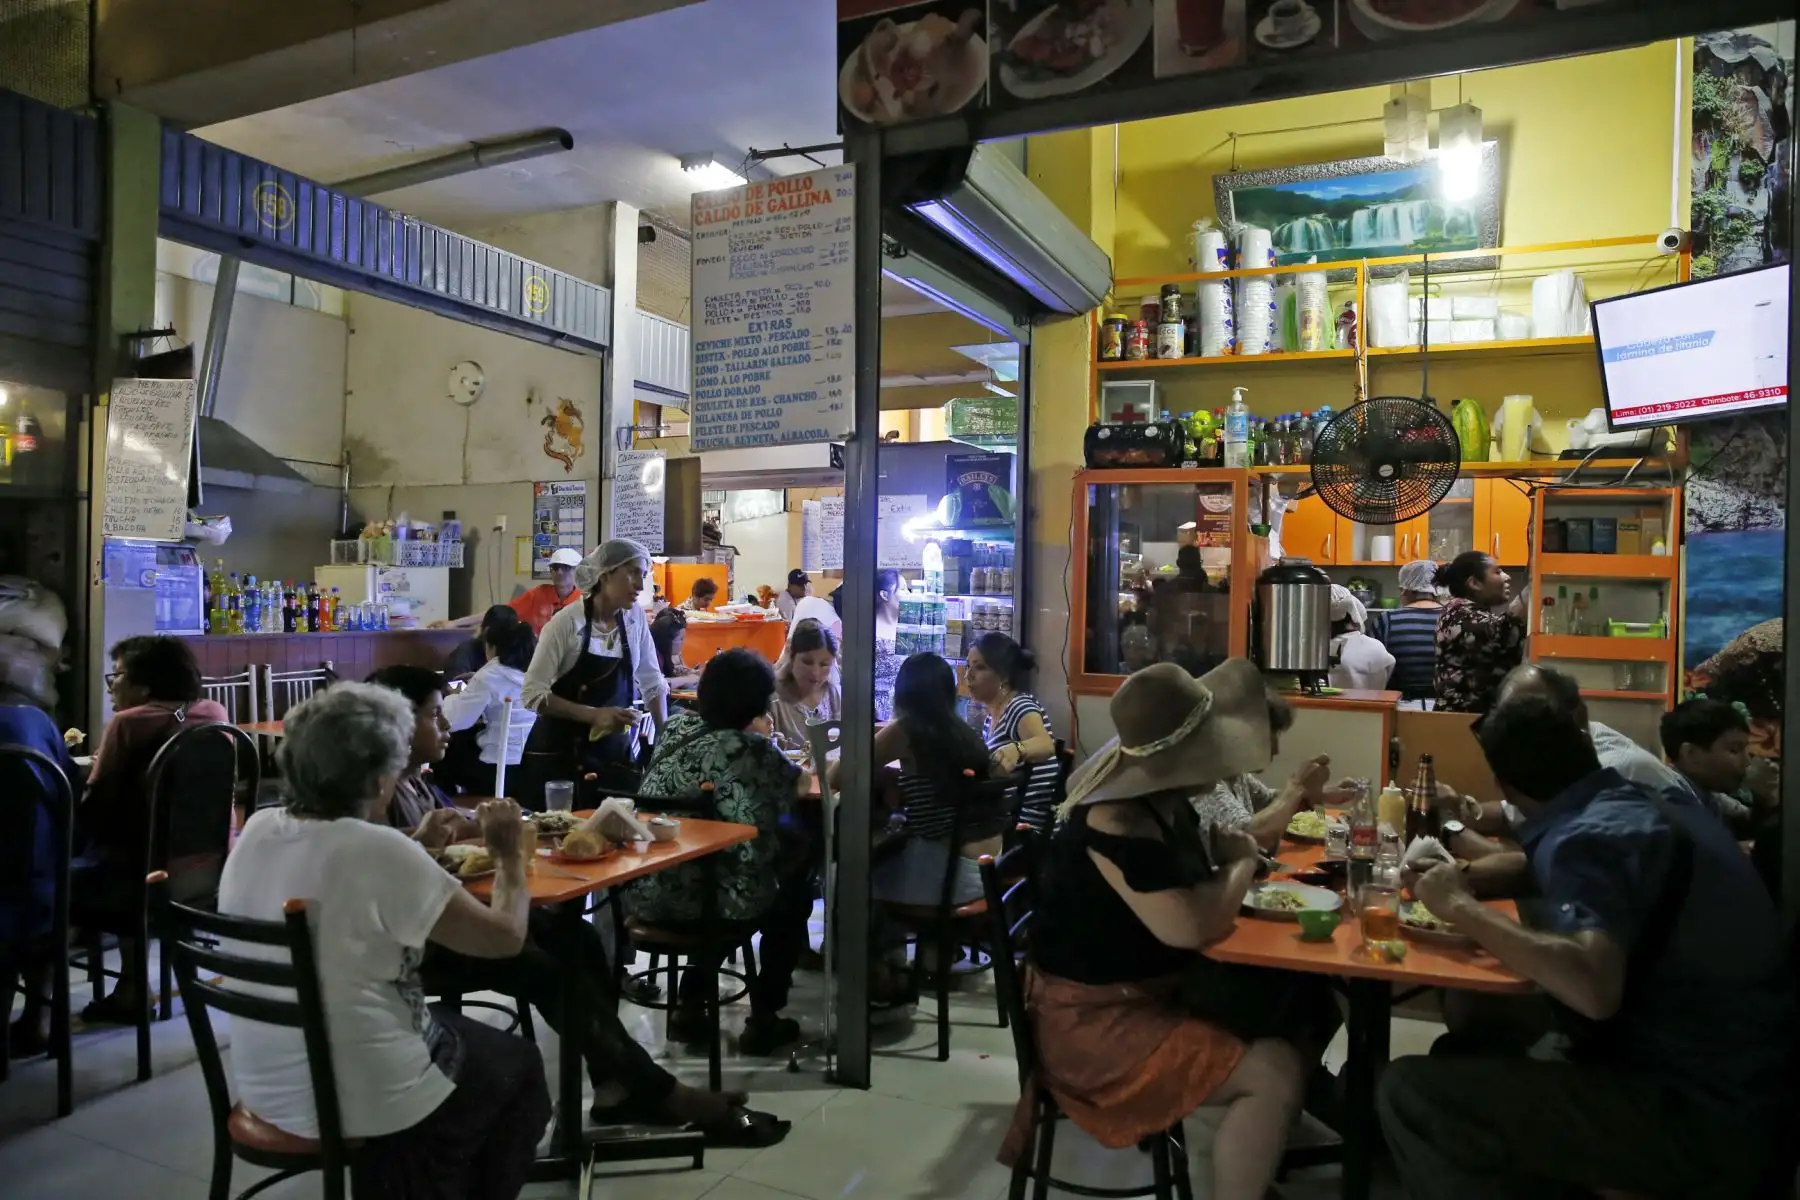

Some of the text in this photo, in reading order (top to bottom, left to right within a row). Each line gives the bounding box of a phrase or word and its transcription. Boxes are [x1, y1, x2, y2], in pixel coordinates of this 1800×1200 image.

[745, 186, 764, 204] DE
[767, 175, 813, 198] POLLO
[695, 206, 740, 226] CALDO
[745, 201, 764, 217] DE
[767, 188, 832, 213] GALLINA
[748, 319, 793, 333] EXTRAS
[695, 338, 733, 352] CEVICHE
[733, 334, 762, 349] MIXTO
[768, 328, 810, 344] PESCADO
[1659, 343, 1674, 354] de
[1675, 337, 1709, 351] titanio
[732, 345, 760, 359] POLLO
[781, 341, 811, 354] POBRE
[695, 363, 719, 376] LOMO
[725, 357, 768, 372] TALLARIN
[770, 352, 812, 367] SALTADO
[695, 375, 719, 388] LOMO
[720, 374, 728, 385] A
[730, 373, 740, 384] LO
[742, 369, 771, 383] POBRE
[695, 384, 761, 401] POLLO DORADO
[695, 398, 735, 413] CHULETA
[736, 396, 748, 408] DE
[749, 394, 767, 407] RES
[772, 391, 818, 405] CHANCHO
[1616, 407, 1637, 418] Lima:
[1638, 405, 1655, 416] (01)
[1656, 400, 1697, 413] 219-3022
[1701, 393, 1742, 406] Chimbote:
[1743, 387, 1782, 399] 46-9310
[695, 410, 738, 425] MILANESA
[740, 408, 752, 420] DE
[754, 407, 783, 419] POLLO
[695, 420, 780, 436] FILETE DE PESCADO
[780, 428, 830, 442] ALBACORA
[560, 496, 584, 506] 2019
